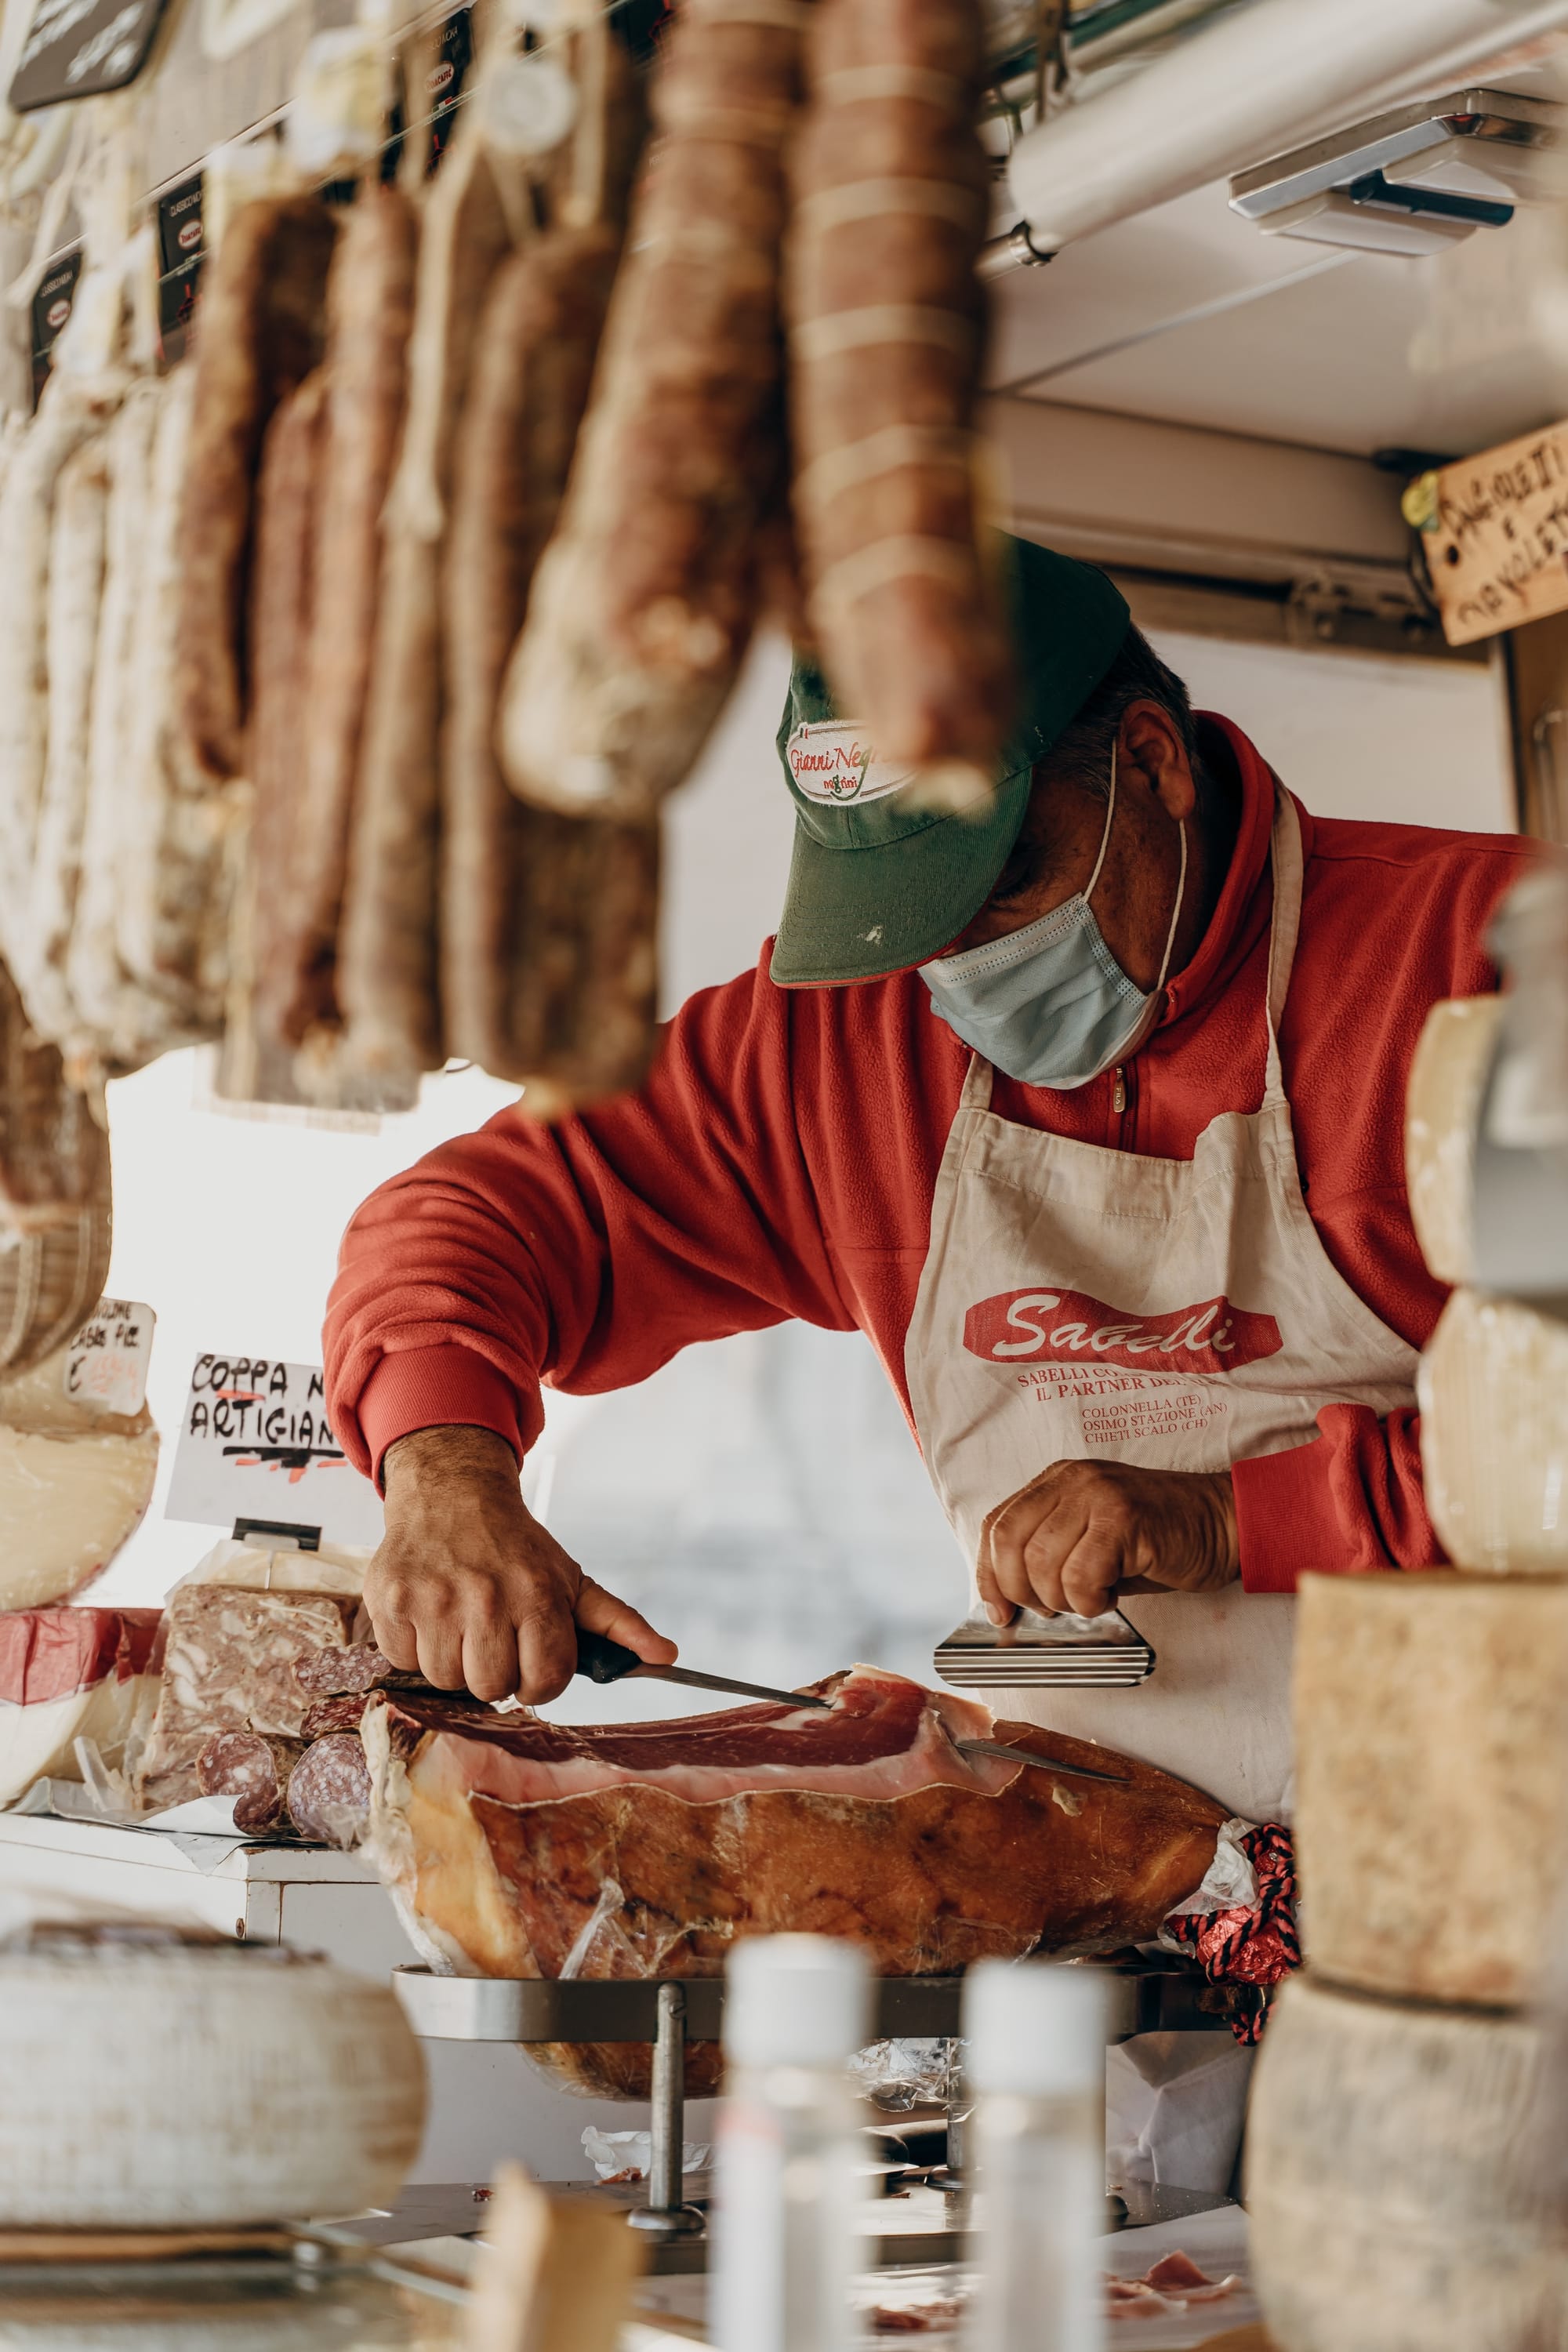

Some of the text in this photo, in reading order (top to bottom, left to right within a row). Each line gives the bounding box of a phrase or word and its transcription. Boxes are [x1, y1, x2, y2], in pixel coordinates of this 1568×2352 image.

[790, 749, 834, 778] Gianni
[823, 774, 858, 793] negrini
[992, 1294, 1236, 1356] Sabelli
[192, 1354, 288, 1399] COPPA
[1018, 1367, 1088, 1388] SABELLI
[1036, 1387, 1051, 1402] IL
[1058, 1375, 1145, 1399] PARTNER
[1082, 1393, 1202, 1419] COLONNELLA (TE)
[1083, 1402, 1228, 1432] OSIMO STAZIONE (AN)
[1084, 1418, 1208, 1443] CHIETI SCALO (CH)
